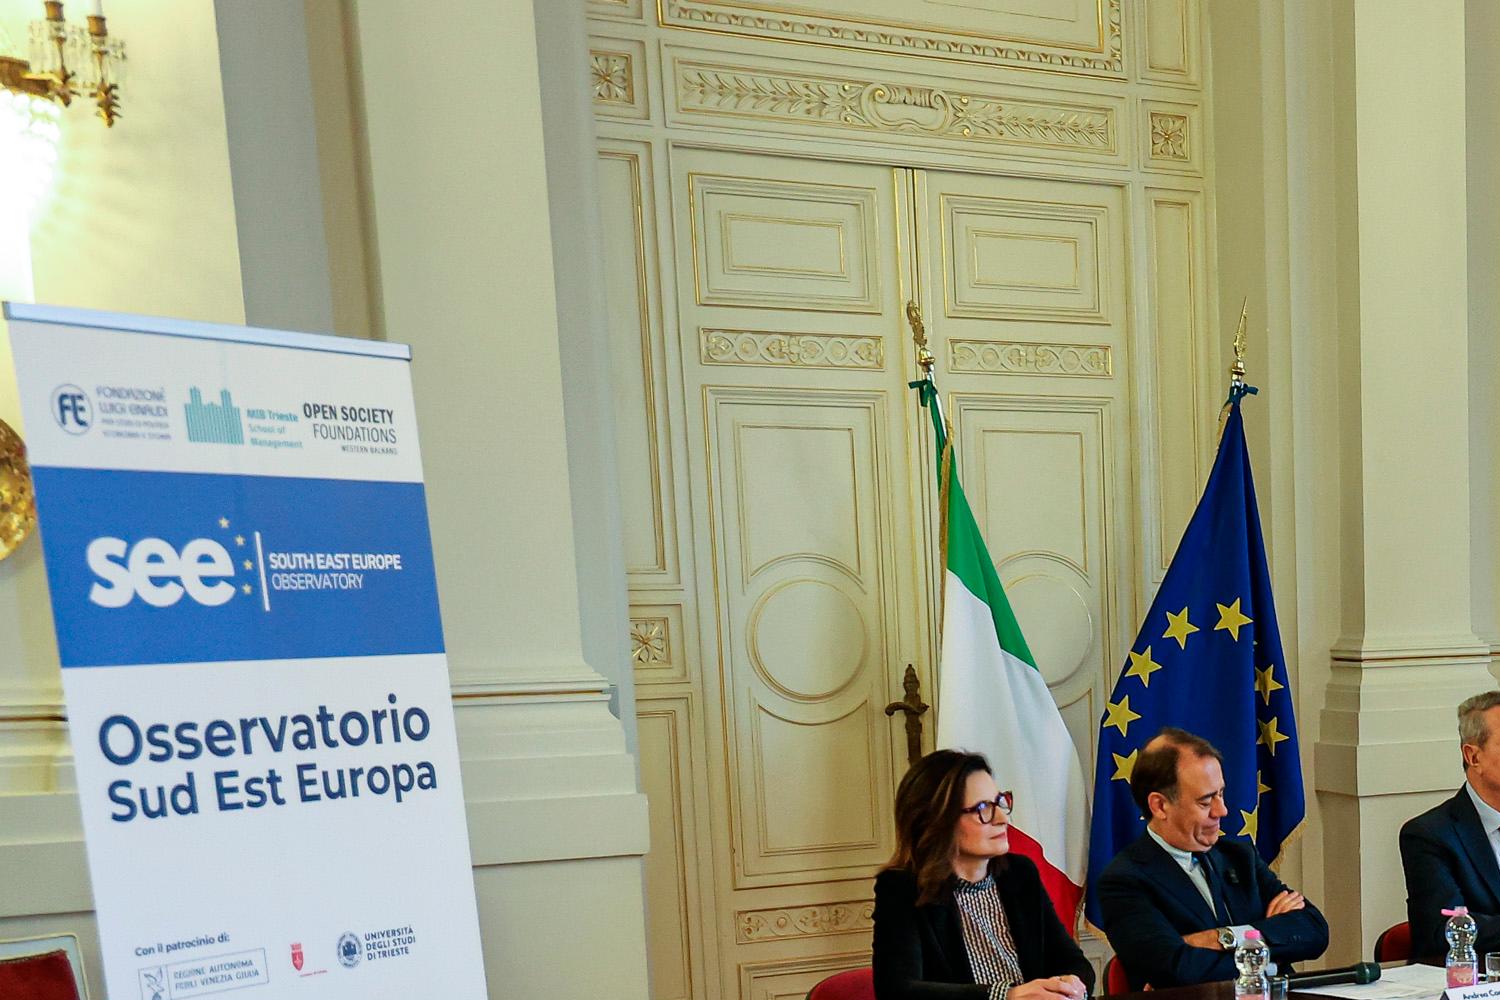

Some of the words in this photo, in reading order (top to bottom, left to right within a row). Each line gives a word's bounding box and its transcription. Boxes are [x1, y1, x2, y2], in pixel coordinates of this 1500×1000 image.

[303, 402, 338, 421] OPEN
[341, 406, 394, 425] SOCIETY
[313, 423, 397, 444] FOUNDATIONS
[251, 438, 303, 449] Management
[269, 552, 315, 570] SOUTH
[316, 553, 350, 570] EAST
[352, 553, 403, 570] EUROPE
[86, 536, 236, 608] see
[271, 572, 364, 590] OBSERVATORY
[99, 693, 431, 766] Osservatorio
[107, 772, 199, 822] Sud
[214, 767, 286, 812] Est
[296, 759, 437, 803] Europa
[135, 946, 155, 957] Con
[157, 942, 164, 953] il
[165, 933, 215, 953] patrocinio
[365, 940, 391, 951] DEGLI
[392, 935, 416, 947] STUDI
[367, 952, 377, 961] DI
[378, 946, 410, 959] TRIESTE
[1463, 991, 1489, 1000] Andrea
